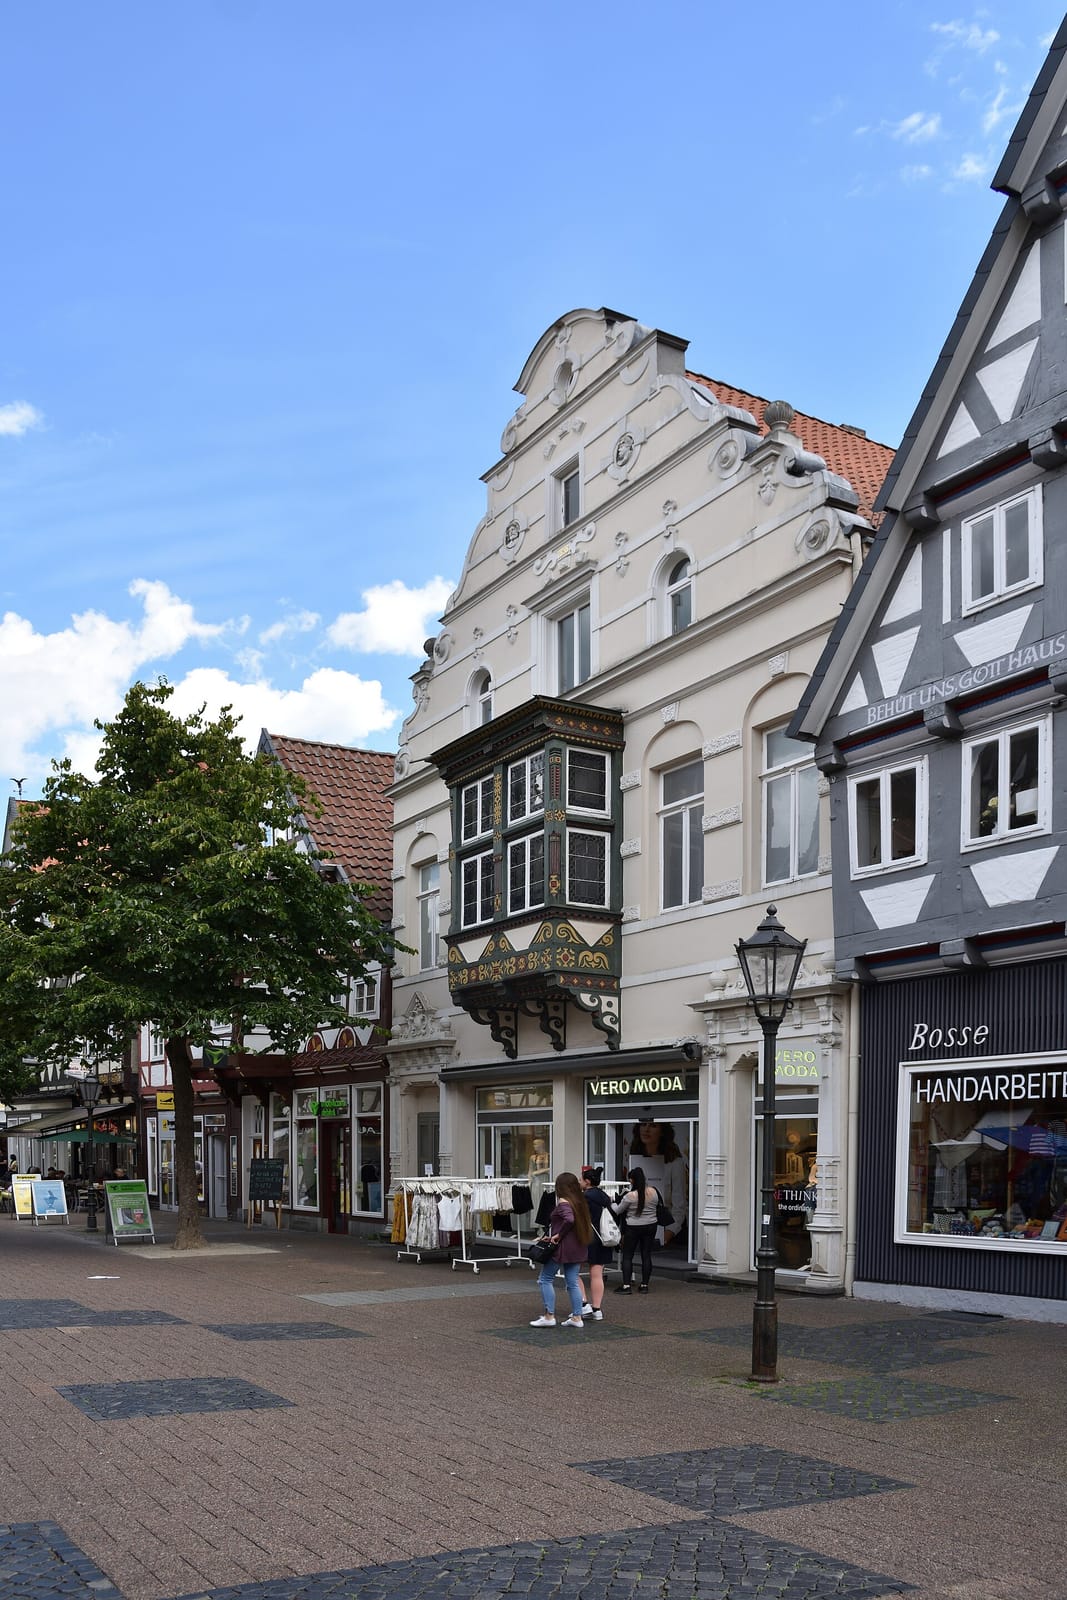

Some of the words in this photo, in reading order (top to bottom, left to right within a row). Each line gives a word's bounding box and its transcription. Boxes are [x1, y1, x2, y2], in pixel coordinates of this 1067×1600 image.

[958, 658, 1006, 689] GOTT
[1008, 634, 1066, 672] HAUS
[908, 1023, 989, 1050] Bosse
[590, 1079, 630, 1096] VERO
[633, 1076, 684, 1093] MODA
